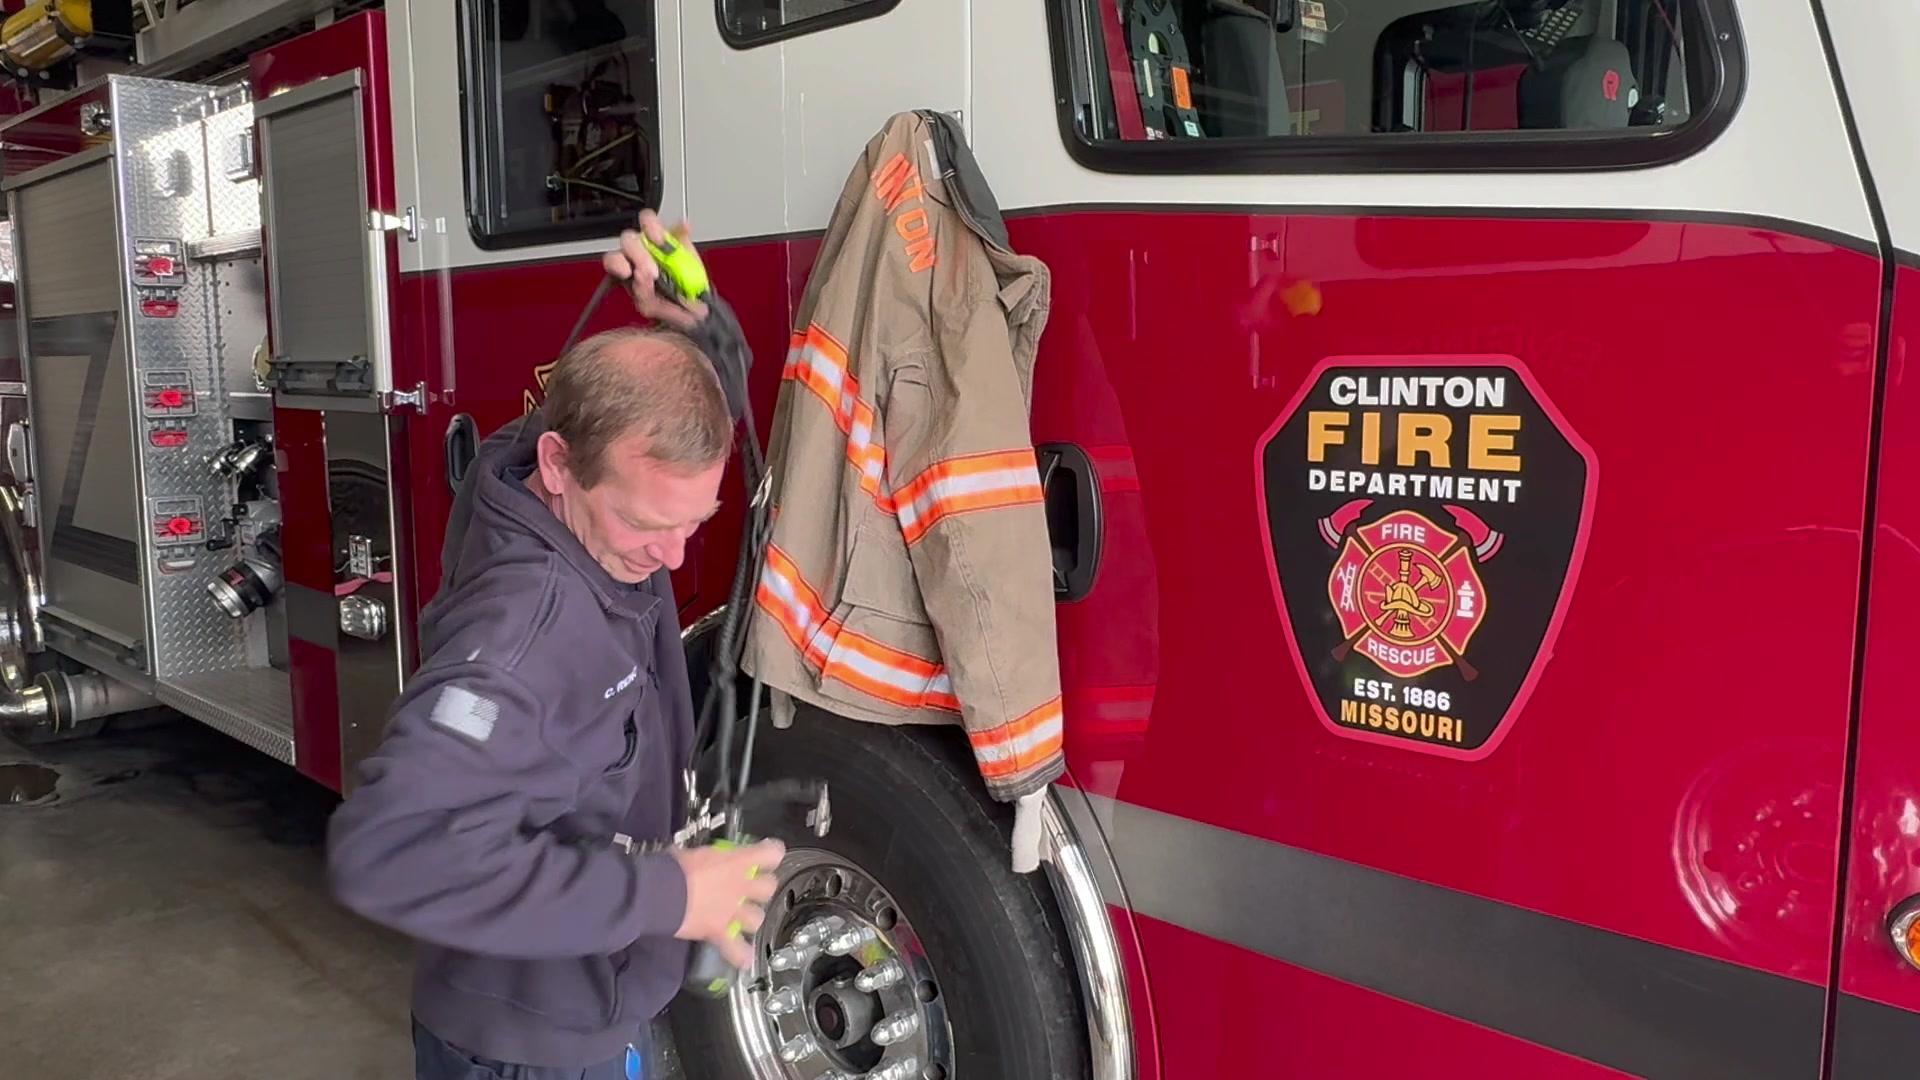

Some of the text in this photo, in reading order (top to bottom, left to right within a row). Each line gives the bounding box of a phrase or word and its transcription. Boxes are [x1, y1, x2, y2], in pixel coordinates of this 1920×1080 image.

[1329, 376, 1505, 407] CLINTON
[1306, 411, 1522, 472] FIRE
[1308, 469, 1522, 503] DEPARTMENT
[1381, 523, 1426, 543] FIRE
[1367, 637, 1436, 666] RESCUE
[1354, 678, 1451, 711] EST. 1886
[1340, 699, 1464, 742] MISSOURI
